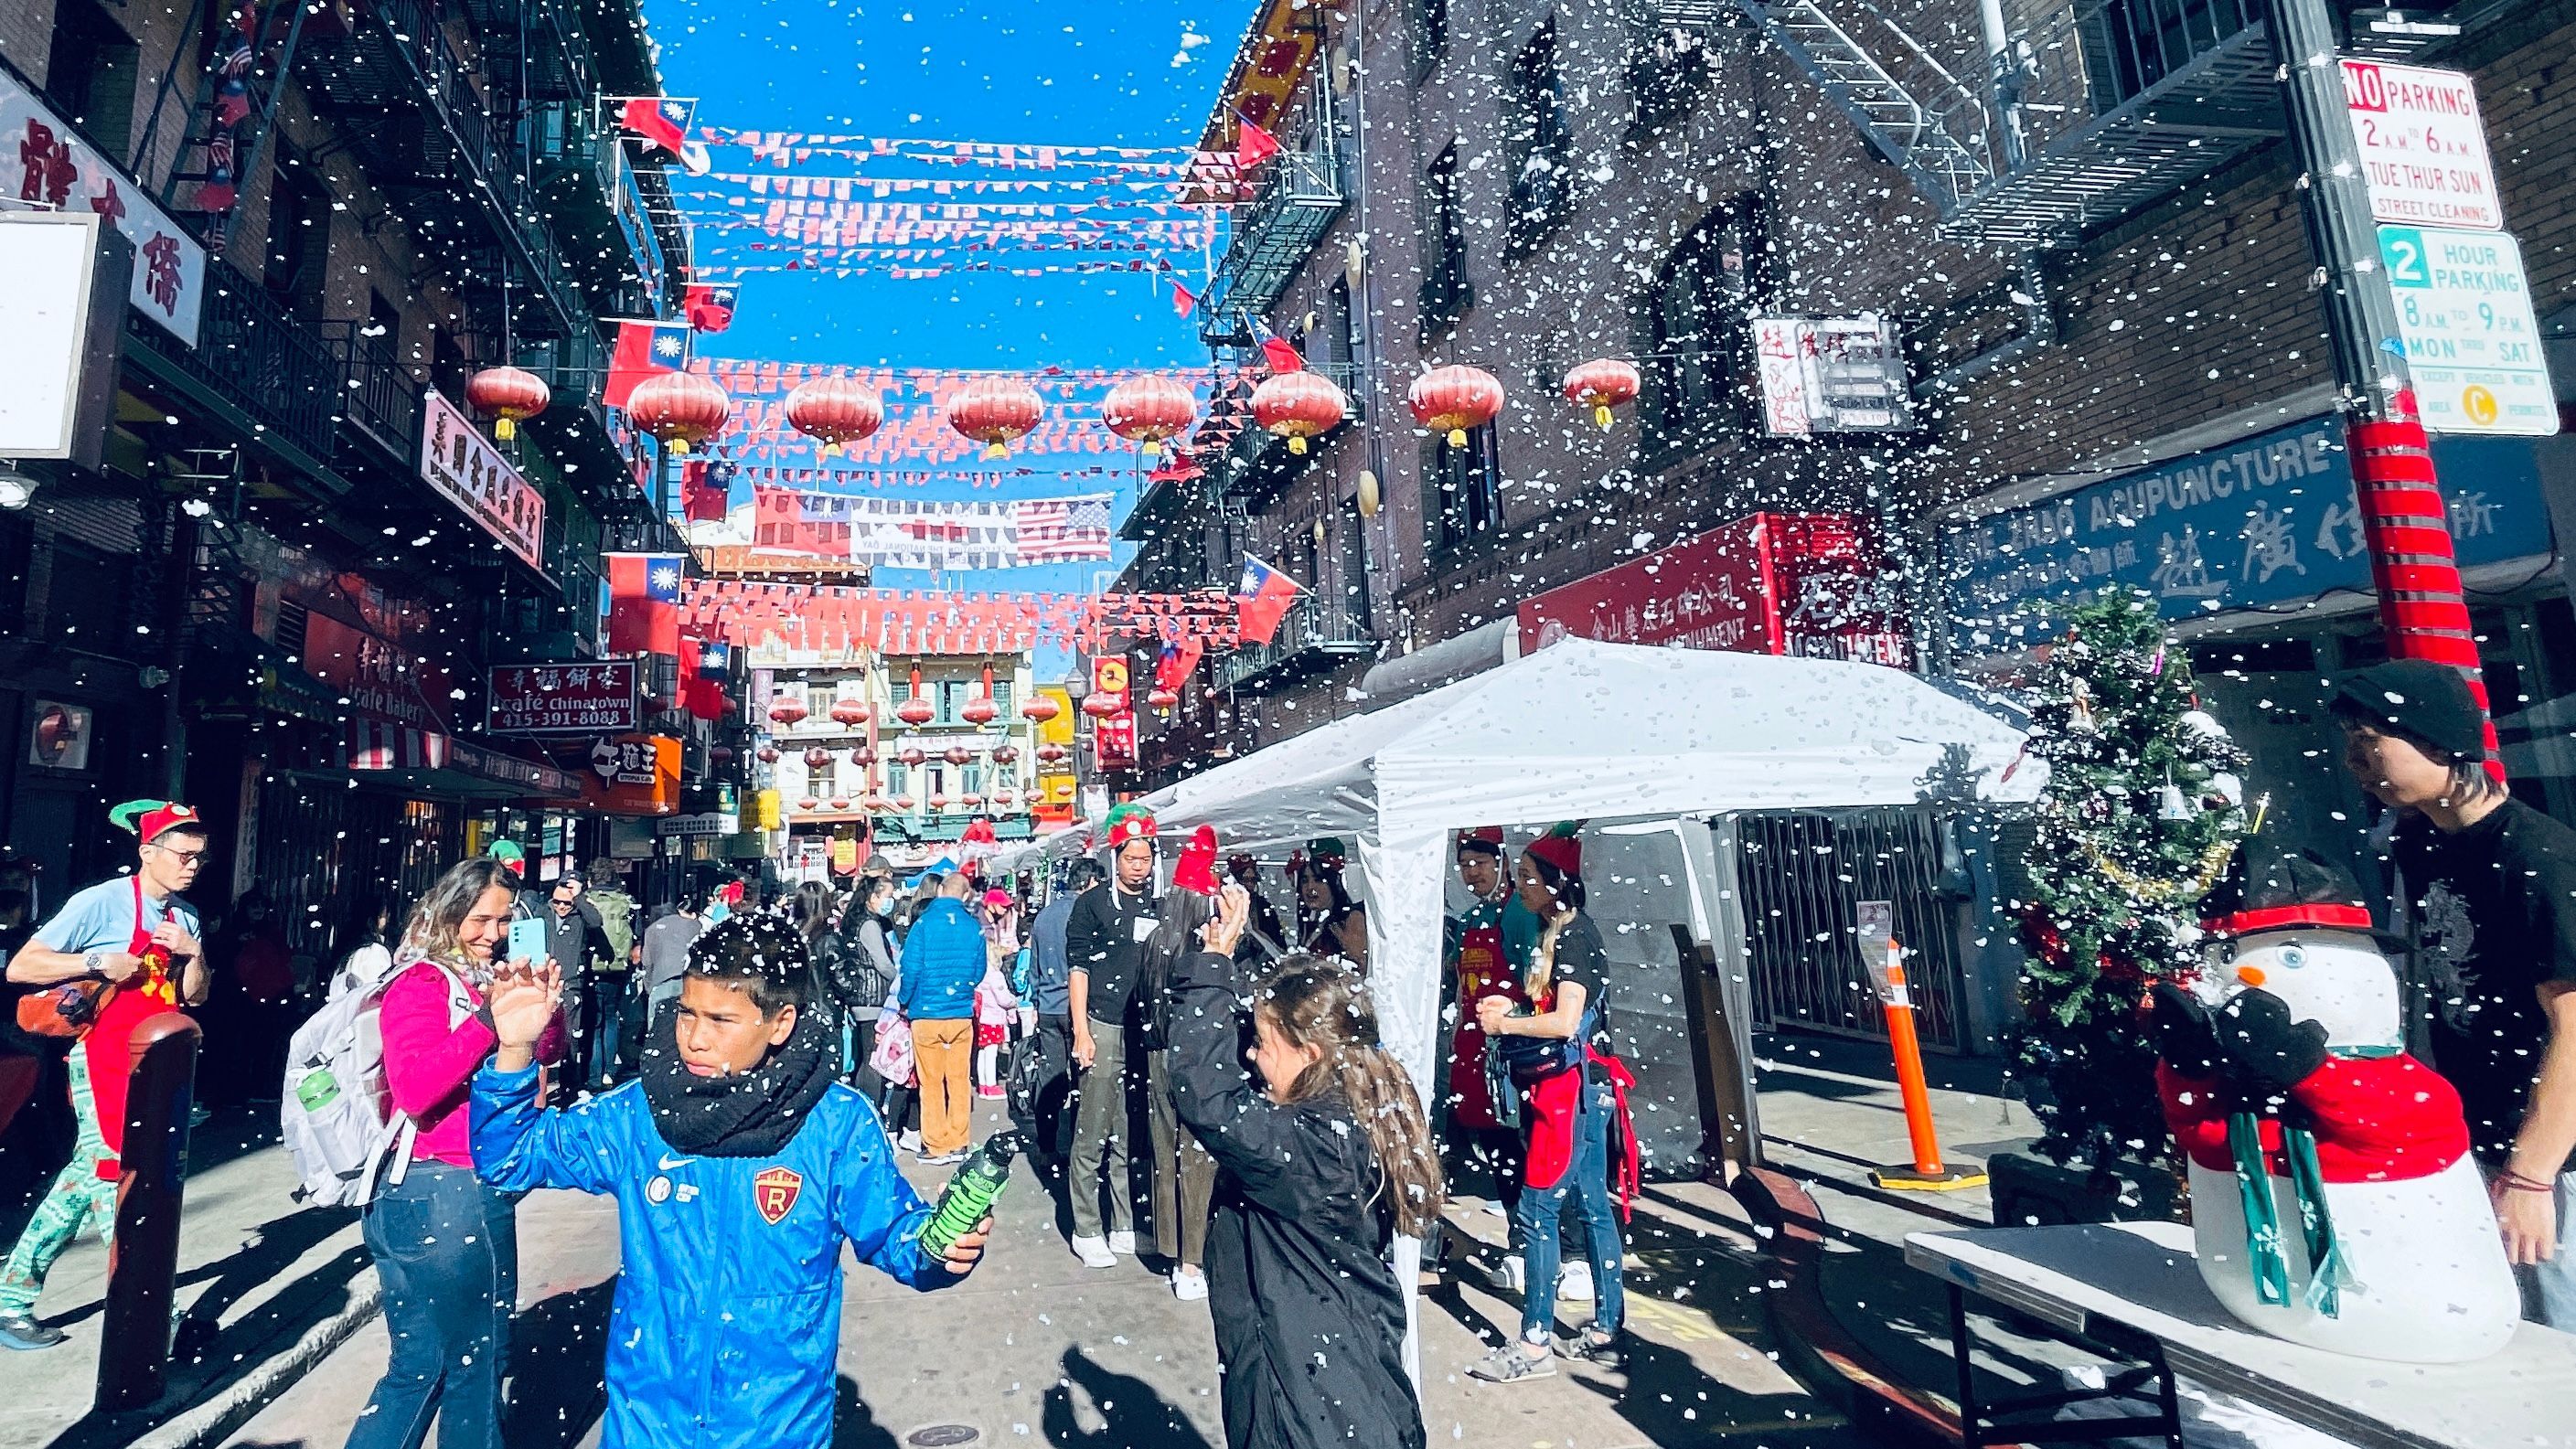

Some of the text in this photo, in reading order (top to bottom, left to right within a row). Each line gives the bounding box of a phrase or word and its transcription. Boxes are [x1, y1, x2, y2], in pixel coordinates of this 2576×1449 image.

[2344, 68, 2470, 116] NO PARKING
[2363, 119, 2379, 146] 2
[2408, 127, 2420, 138] TO
[2426, 126, 2440, 154] 6
[2368, 162, 2483, 195] TUE THUR SUN
[2378, 198, 2488, 221] STREET CLEANING
[2391, 240, 2497, 281] 2 HOUR
[2436, 269, 2519, 292] PARKING
[2403, 297, 2420, 326] 8
[2478, 303, 2494, 330] 9
[2409, 337, 2456, 358] MON
[2499, 342, 2530, 363] SAT
[2472, 390, 2490, 421] C
[2090, 430, 2331, 533] ACUPUNCTURE
[508, 666, 622, 692] 幸福餅家
[549, 697, 630, 710] Chinatown
[502, 710, 620, 727] 415-391-8088
[766, 1188, 786, 1212] R
